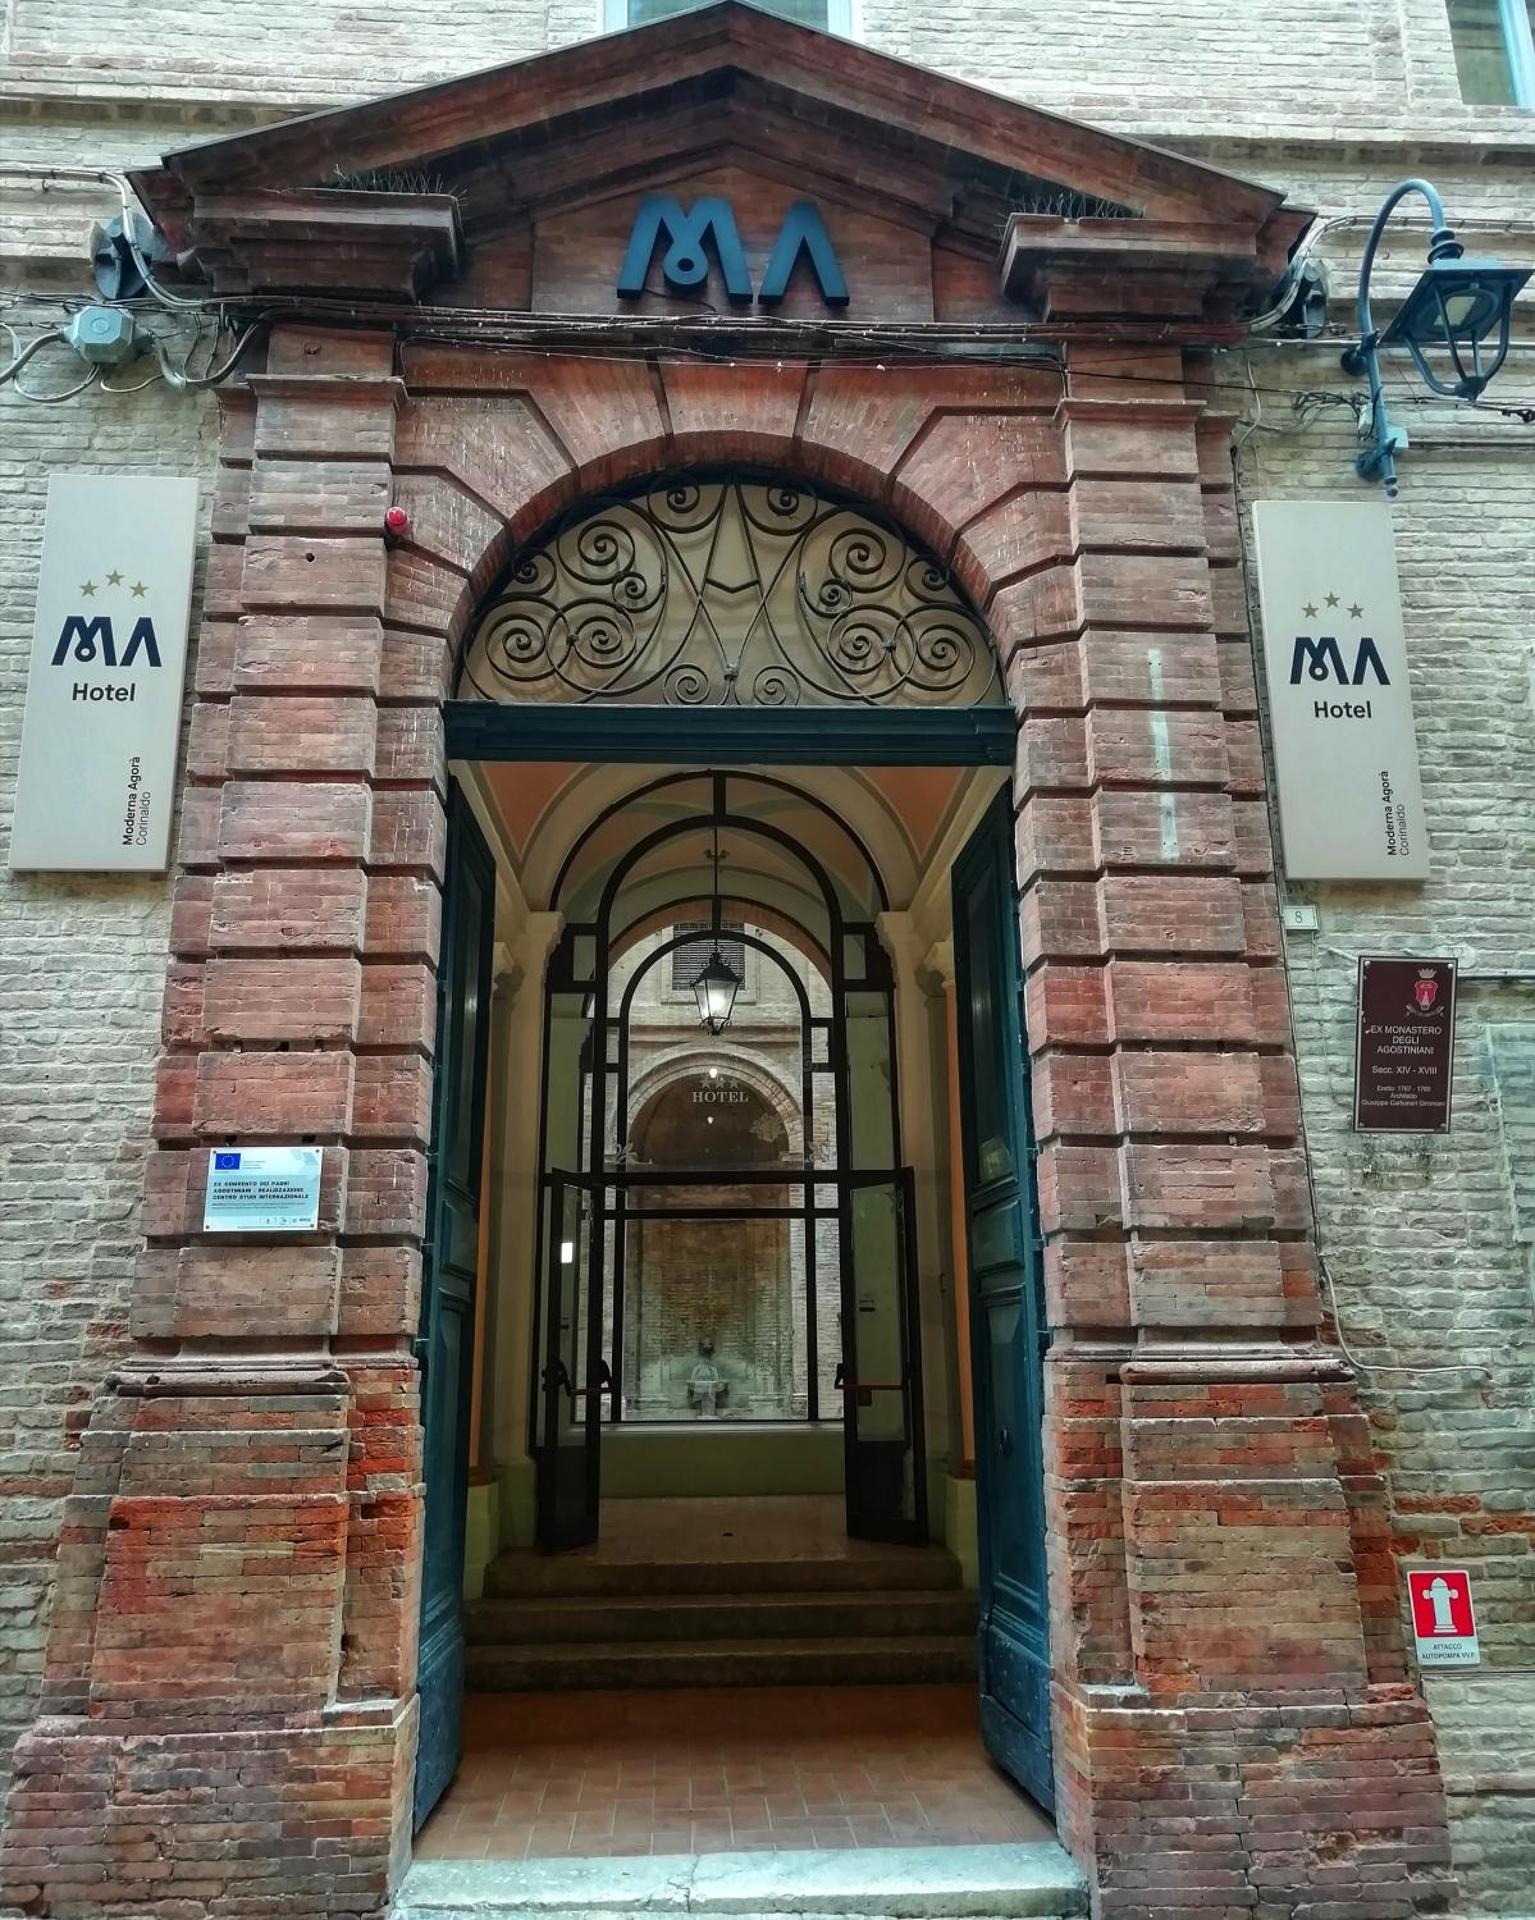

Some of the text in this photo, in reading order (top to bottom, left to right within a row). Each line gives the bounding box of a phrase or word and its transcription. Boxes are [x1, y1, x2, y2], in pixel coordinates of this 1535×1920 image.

[72, 682, 136, 702] Hotel
[1314, 700, 1372, 719] Hotel
[122, 756, 142, 846] Moderna Agorà
[135, 791, 151, 846] Corinaldo
[1379, 770, 1398, 856] Moderna Agorà
[1396, 803, 1410, 856] Corinaldo
[1295, 910, 1303, 924] 8
[1370, 1025, 1442, 1035] EX MONASTERO
[1392, 1035, 1420, 1044] DEGLI
[1377, 1045, 1434, 1055] AGOSTINIANI
[1396, 1066, 1411, 1074] XIV
[1418, 1066, 1438, 1075] XVIII
[692, 1091, 749, 1103] HOTEL
[1433, 1642, 1463, 1650] ATTACCO
